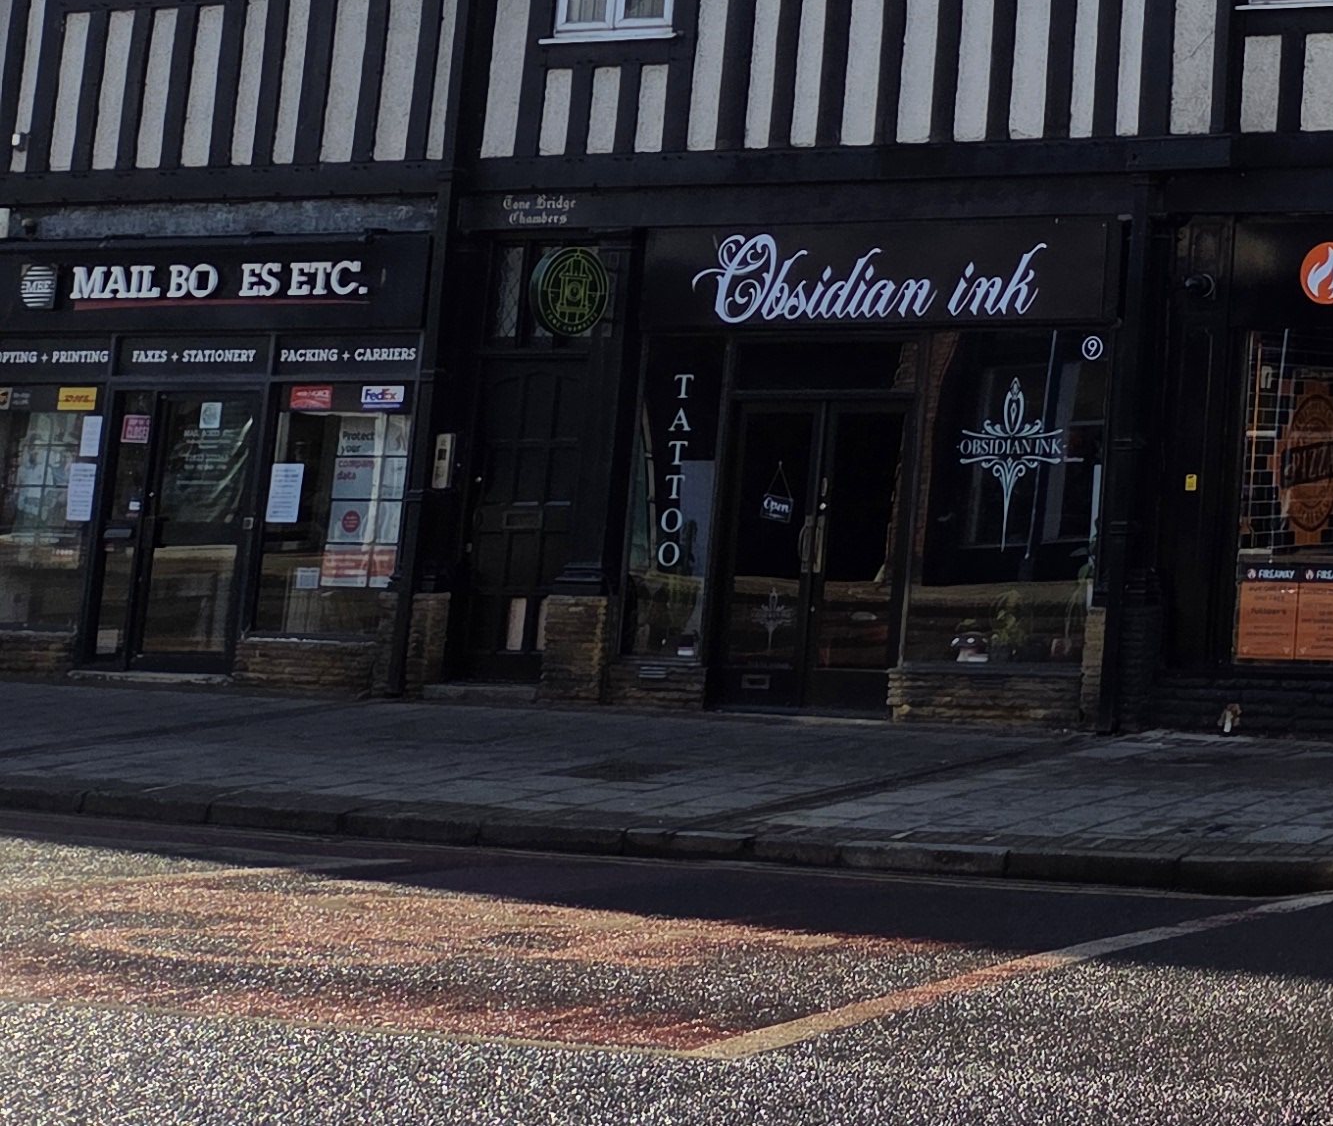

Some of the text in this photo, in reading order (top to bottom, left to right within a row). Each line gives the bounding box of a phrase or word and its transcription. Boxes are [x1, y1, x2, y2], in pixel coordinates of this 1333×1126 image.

[535, 194, 577, 211] Bridge
[508, 211, 568, 225] Chambers
[69, 265, 161, 299] MAIL
[287, 260, 369, 296] ETC.
[692, 233, 1048, 324] Obsidian ink
[0, 351, 38, 364] PYING
[51, 350, 109, 364] PRINTING
[132, 349, 168, 363] FAXES
[181, 348, 256, 363] STATIONERY
[280, 348, 337, 363] PACKING
[354, 347, 417, 362] CARRIERS
[364, 388, 398, 401] FedEx
[342, 430, 375, 441] Protect
[341, 444, 361, 455] your
[960, 437, 1063, 456] OBSIDIAN INK
[656, 373, 695, 568] TATTOO
[763, 497, 790, 515] Open
[1258, 569, 1295, 580] FIREAWAY
